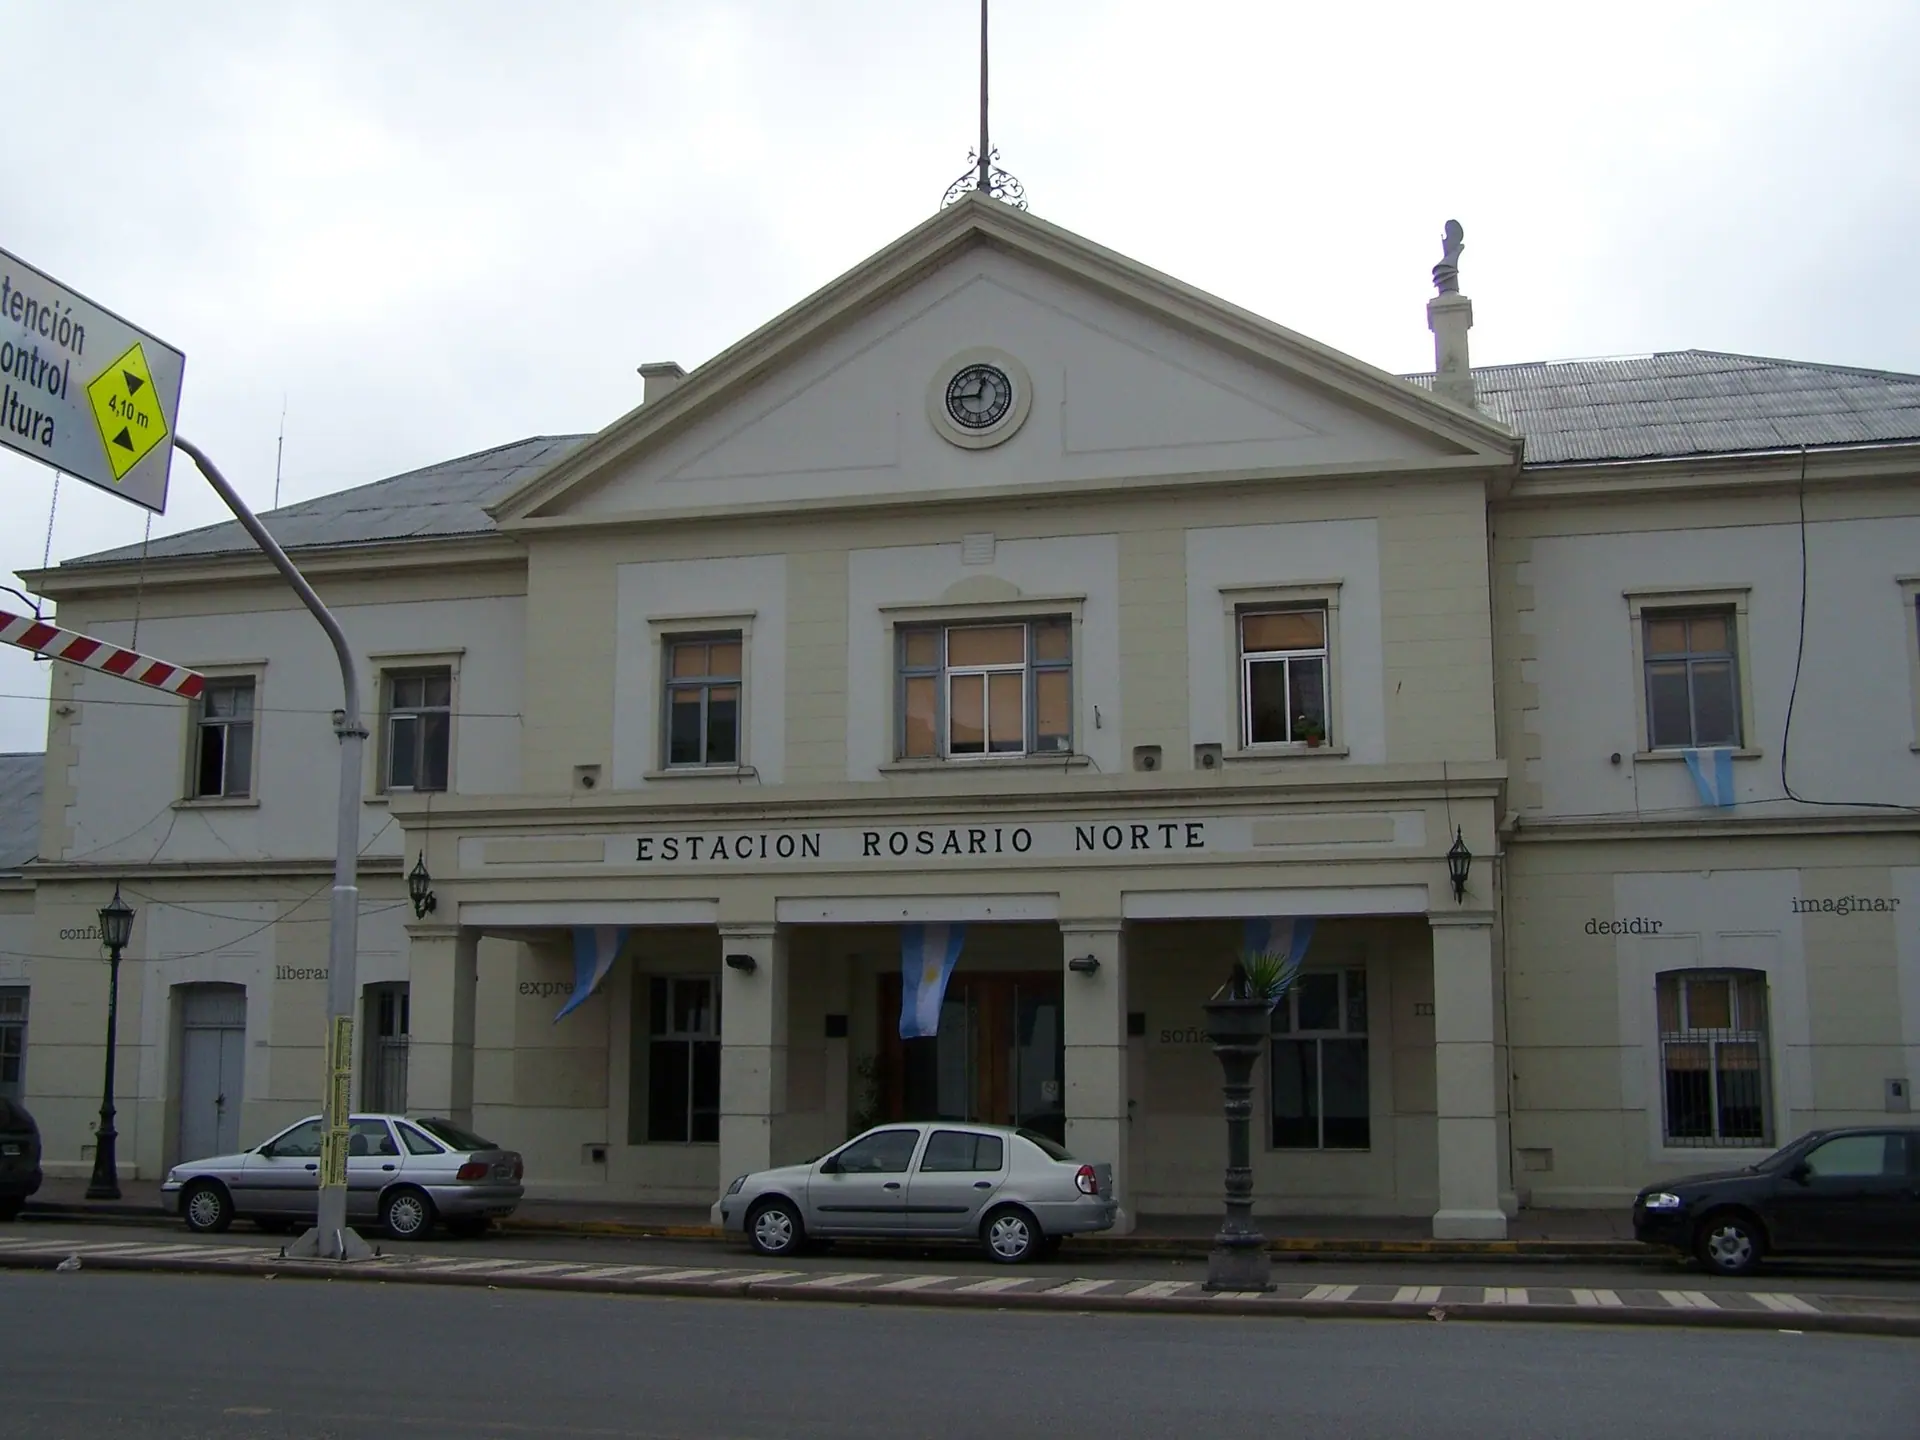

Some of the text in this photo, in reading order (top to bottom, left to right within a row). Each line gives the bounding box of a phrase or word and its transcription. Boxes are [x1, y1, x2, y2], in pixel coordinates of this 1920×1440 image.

[2, 275, 85, 355] tención
[1, 341, 69, 400] ontrol
[0, 384, 55, 447] ltura
[108, 394, 149, 428] 4,10 m
[635, 823, 1205, 861] ESTACION ROSARIO NORTE
[1791, 895, 1900, 915] imaginar
[60, 925, 104, 940] confia
[1584, 917, 1662, 935] decidir
[1160, 1026, 1213, 1043] soña
